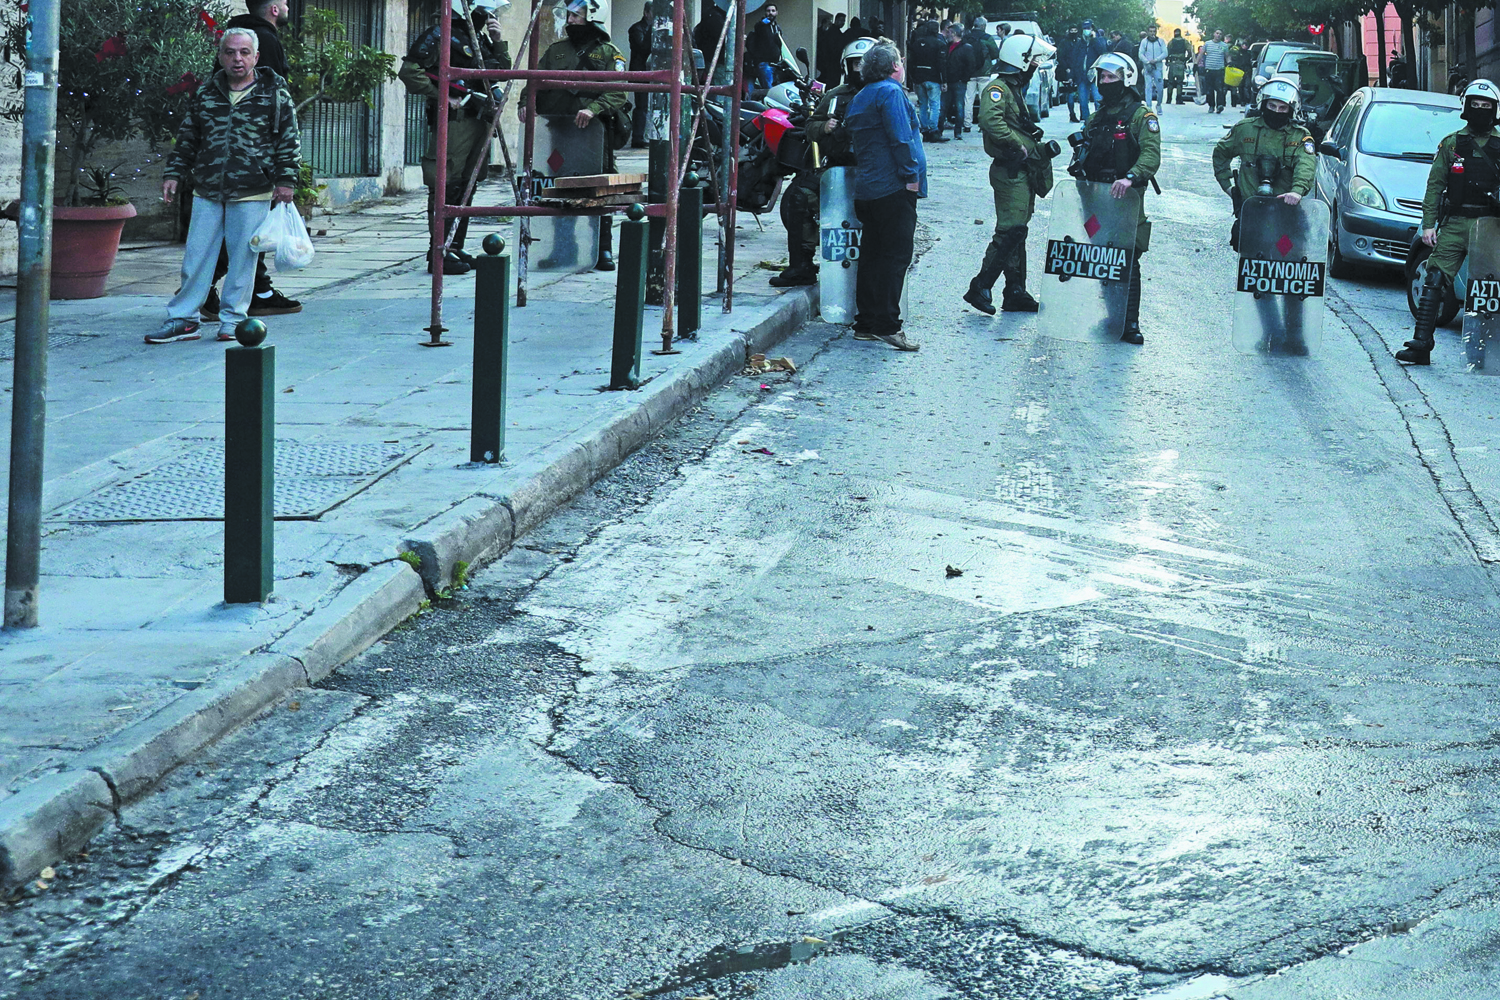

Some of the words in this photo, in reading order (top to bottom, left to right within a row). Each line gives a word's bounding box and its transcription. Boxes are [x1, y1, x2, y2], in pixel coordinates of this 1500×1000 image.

[1050, 241, 1127, 267] ΑΣΤΥΝΟΜΙΑ
[1051, 258, 1122, 281] POLICE
[1241, 259, 1320, 281] ΑΣΤΥΝΟΜΙΑ
[1243, 276, 1316, 295] POLICE
